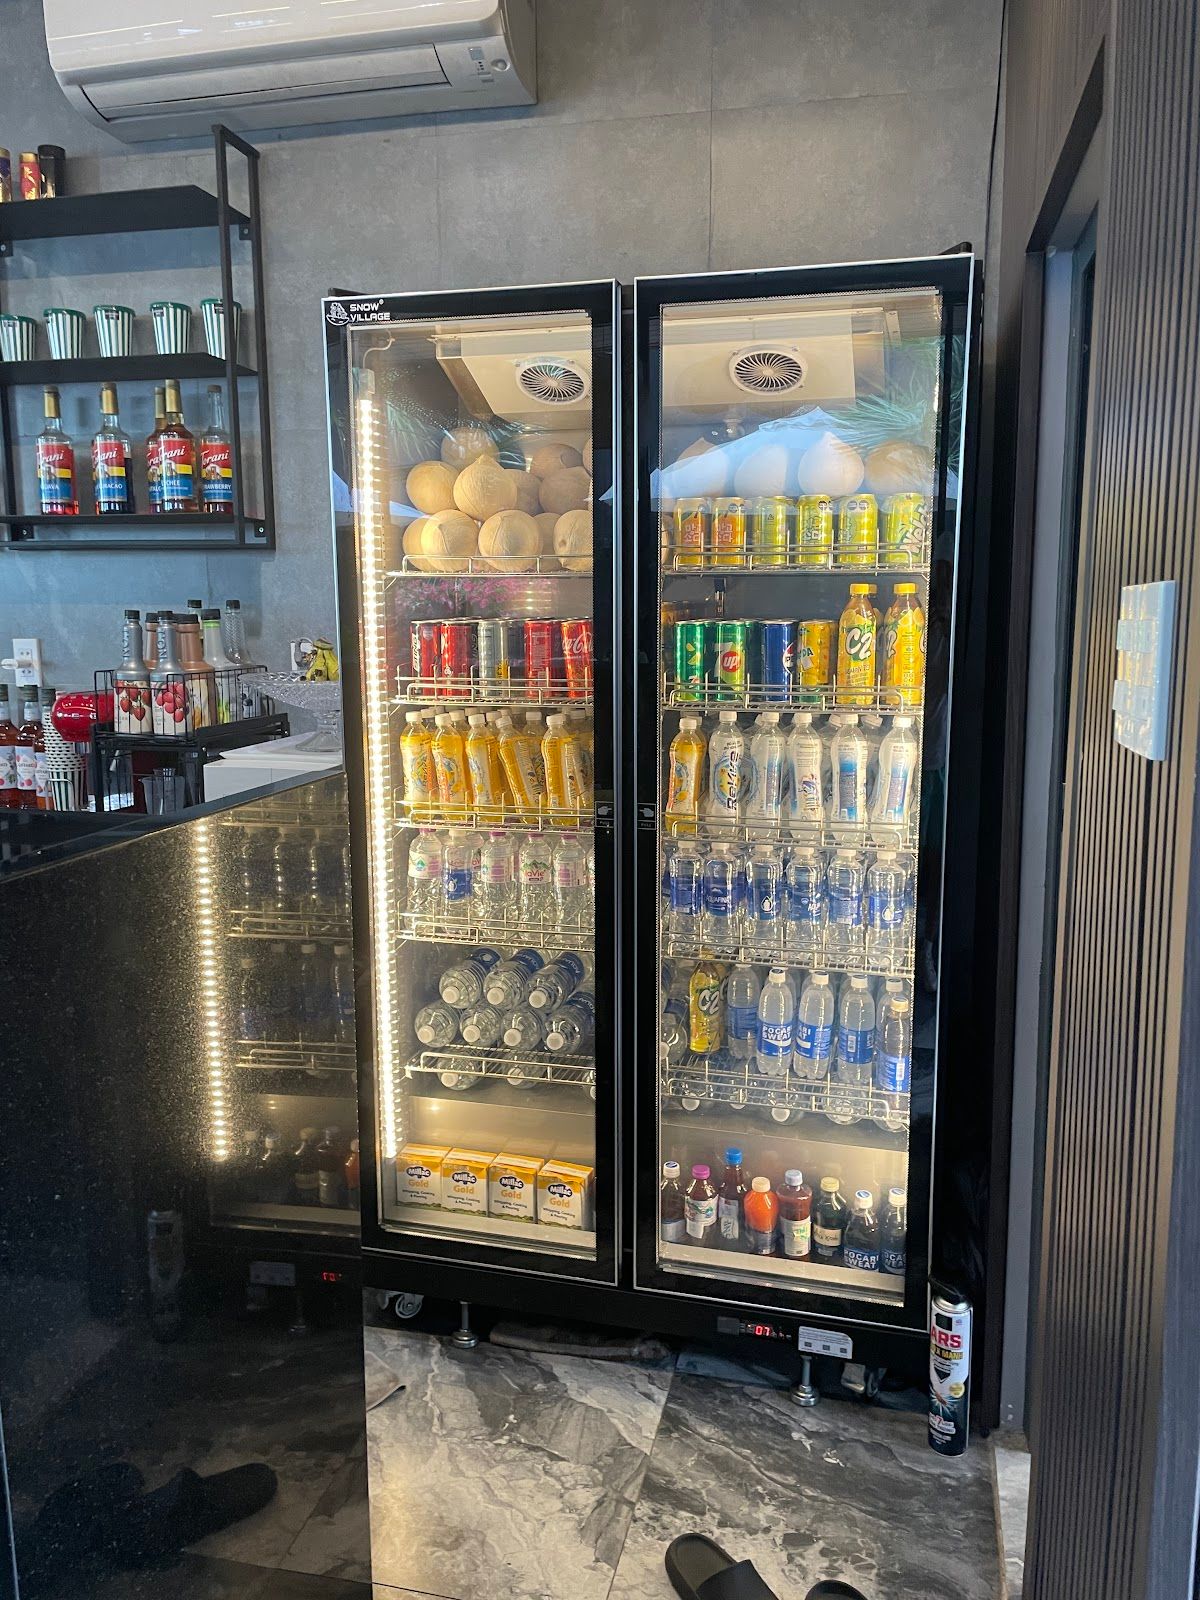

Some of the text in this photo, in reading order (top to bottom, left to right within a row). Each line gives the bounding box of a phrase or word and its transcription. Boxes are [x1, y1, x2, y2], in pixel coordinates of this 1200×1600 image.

[349, 302, 380, 312] SNOW
[349, 312, 391, 323] VILLAGE
[845, 626, 874, 660] C2
[697, 989, 720, 1015] C2
[408, 1167, 430, 1176] Millac
[408, 1179, 430, 1188] Gold
[453, 1173, 477, 1184] Millac
[501, 1178, 523, 1188] Millac
[453, 1185, 475, 1194] Gold
[500, 1190, 523, 1200] Gold
[549, 1185, 572, 1197] Millac
[549, 1197, 571, 1208] Gold
[755, 1326, 770, 1337] 07
